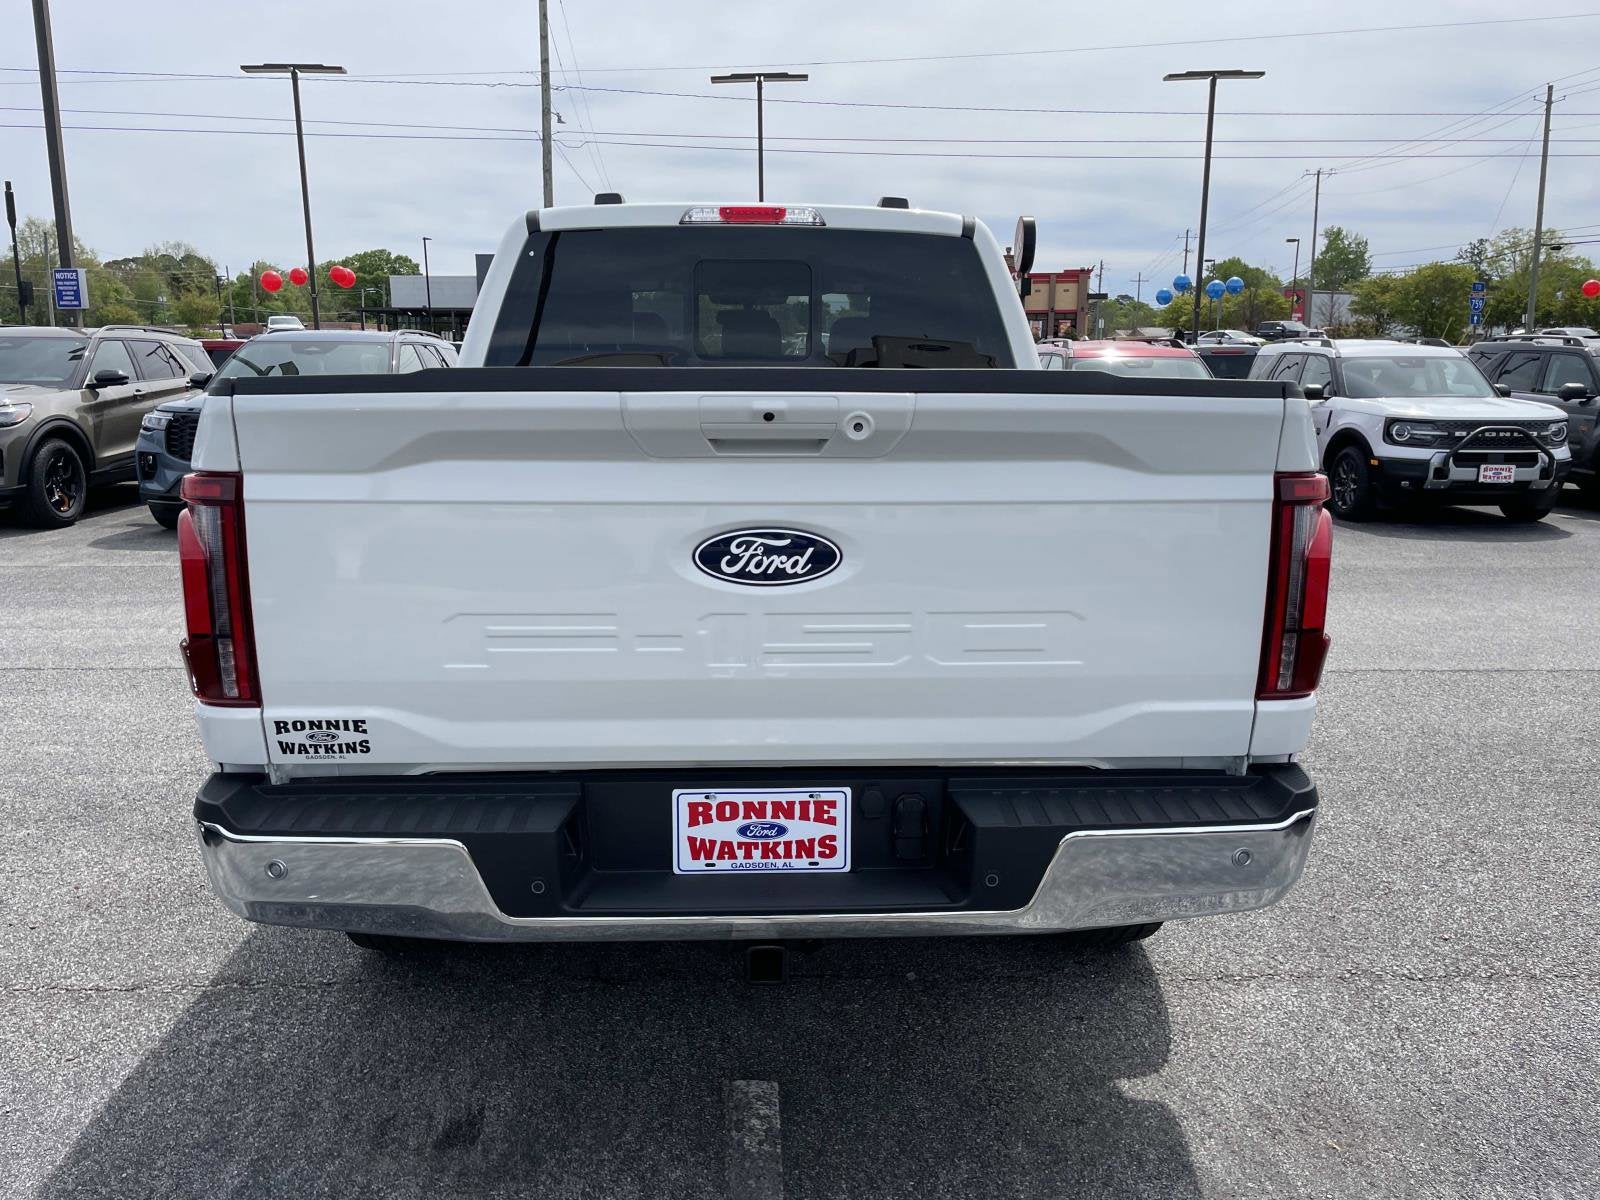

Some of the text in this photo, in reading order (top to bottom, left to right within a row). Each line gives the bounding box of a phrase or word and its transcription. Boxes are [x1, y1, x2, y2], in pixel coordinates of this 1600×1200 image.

[56, 272, 77, 280] NOTICE
[1471, 299, 1483, 309] 759
[720, 536, 815, 575] Ford
[442, 611, 1086, 668] F-150
[273, 719, 368, 735] RONNIE
[277, 739, 371, 754] WATKINS
[687, 799, 838, 828] RONNIE
[746, 823, 778, 837] Ford
[687, 834, 838, 861] WATKINS
[730, 861, 795, 869] GADSDEN, AL
